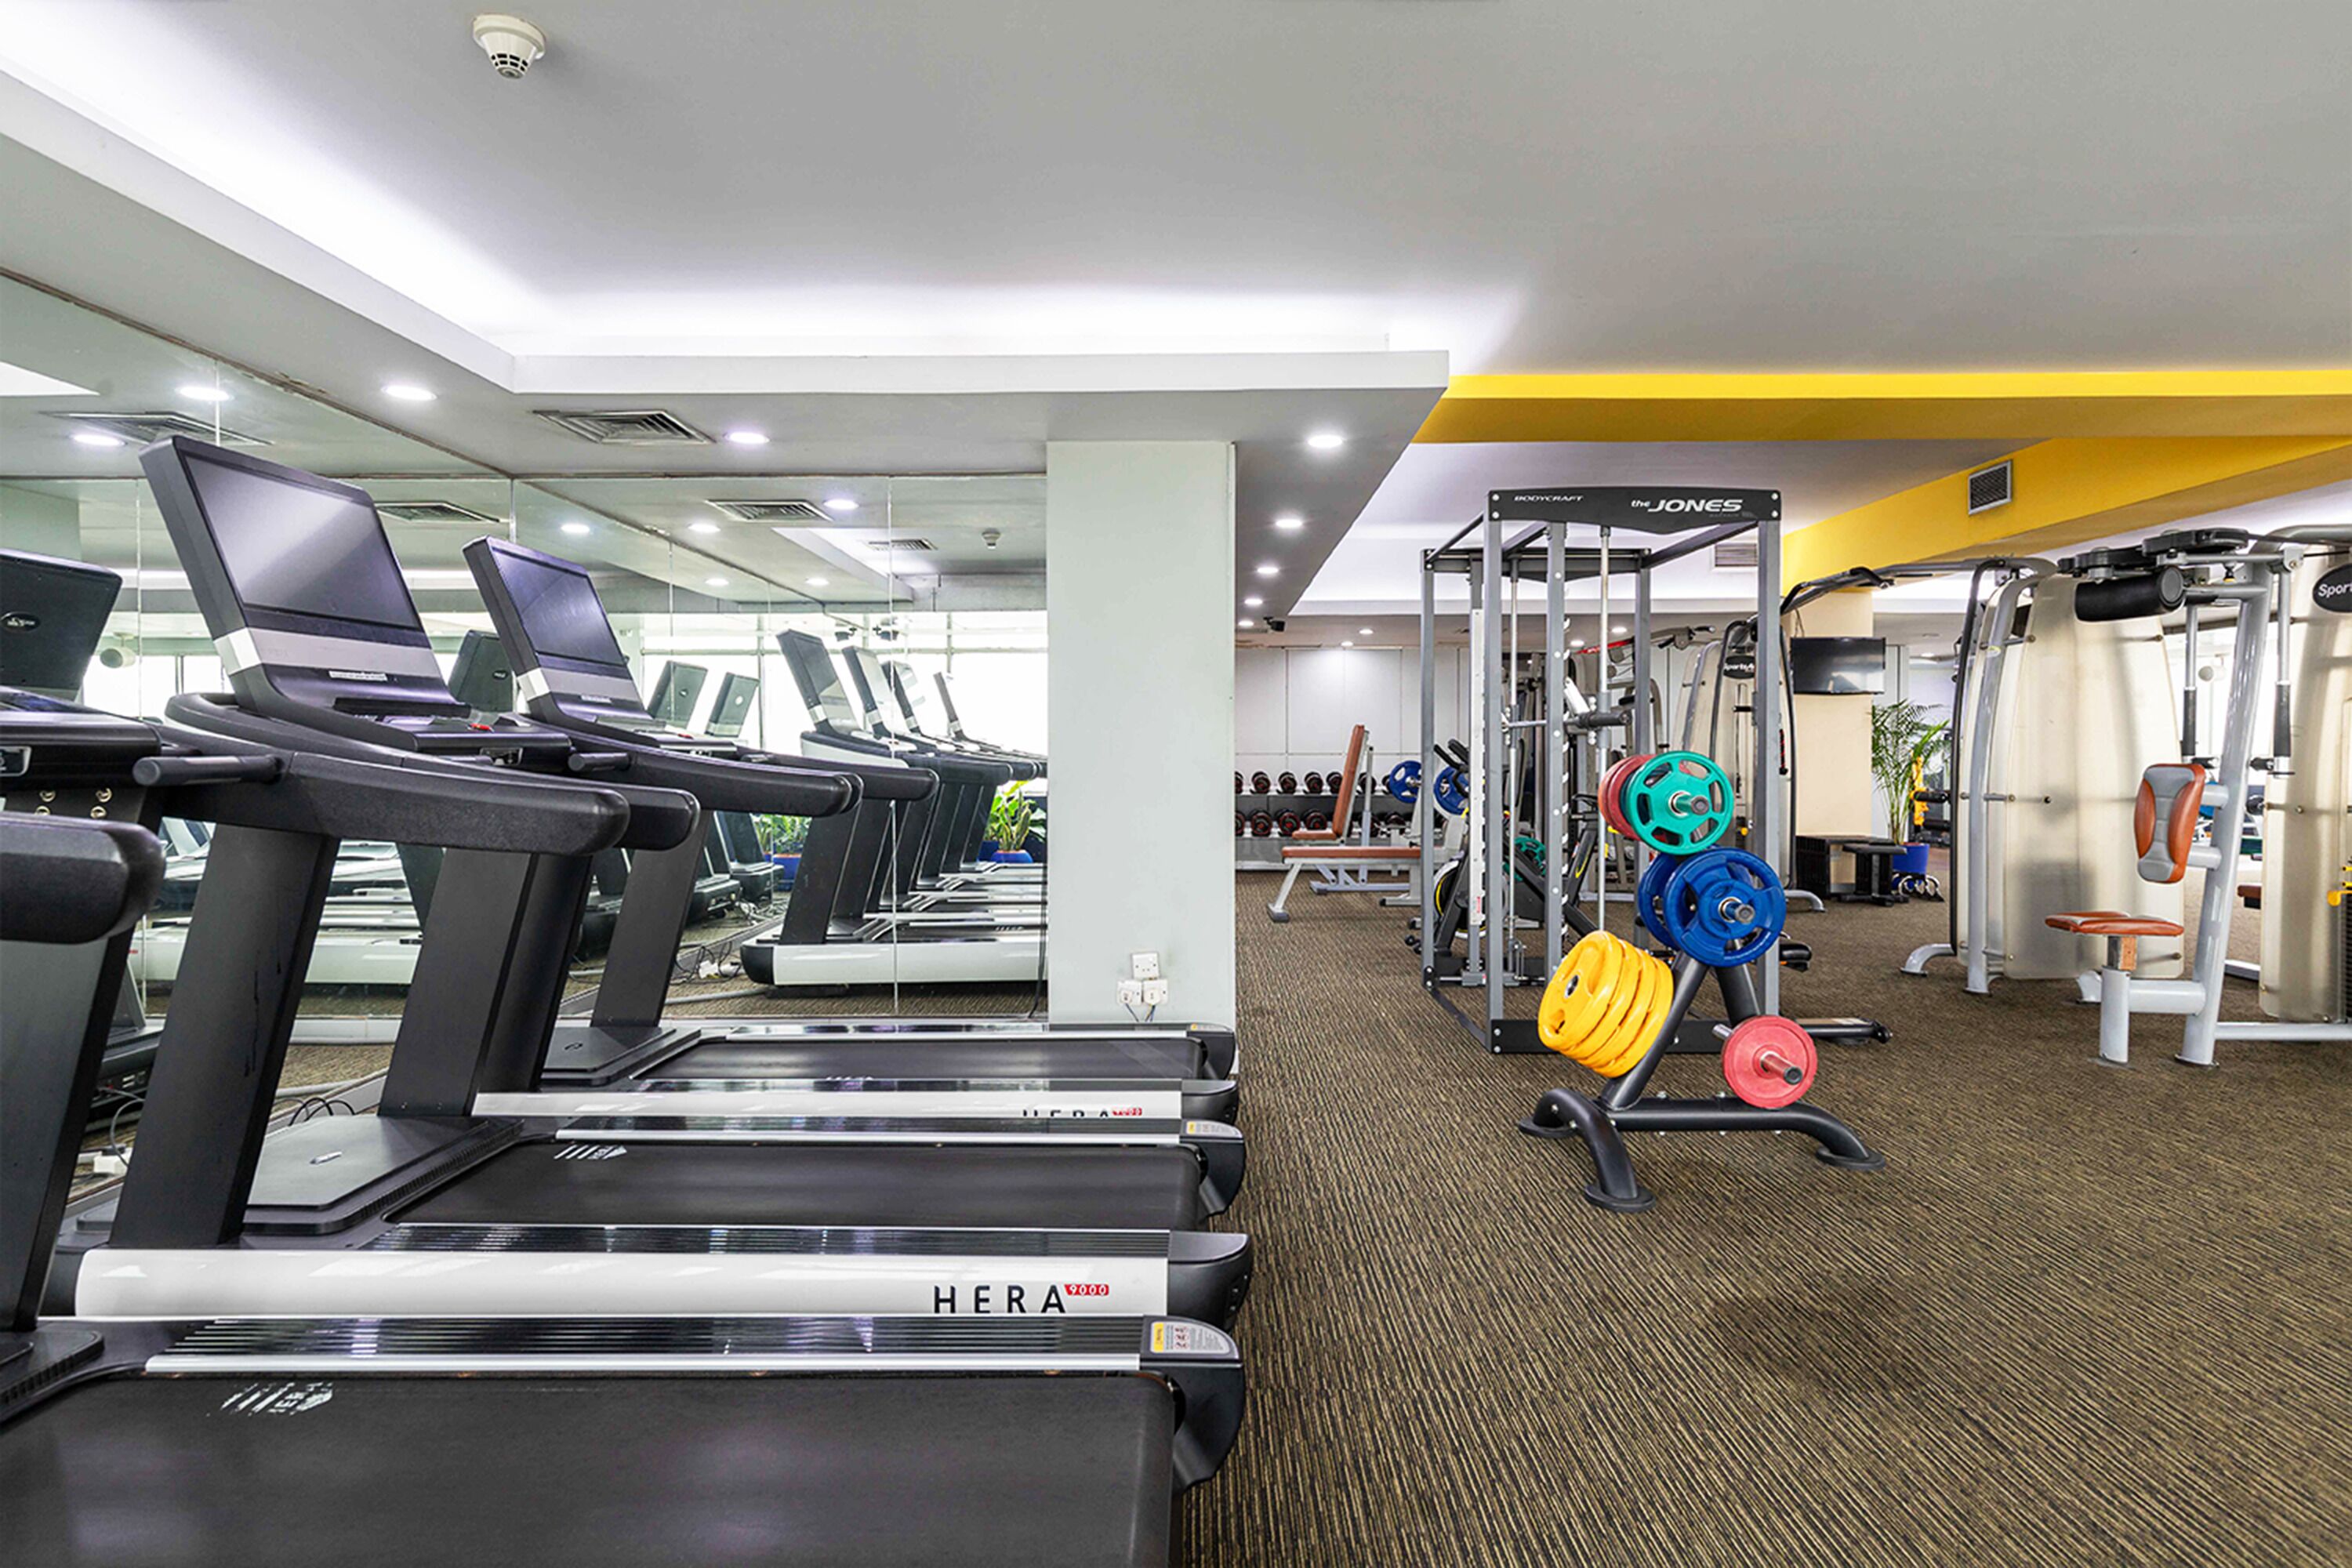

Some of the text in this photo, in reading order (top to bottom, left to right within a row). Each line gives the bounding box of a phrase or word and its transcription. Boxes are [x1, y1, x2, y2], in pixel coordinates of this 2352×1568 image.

[1631, 499, 1744, 513] the JONES
[934, 1284, 1107, 1314] HERA 9000
